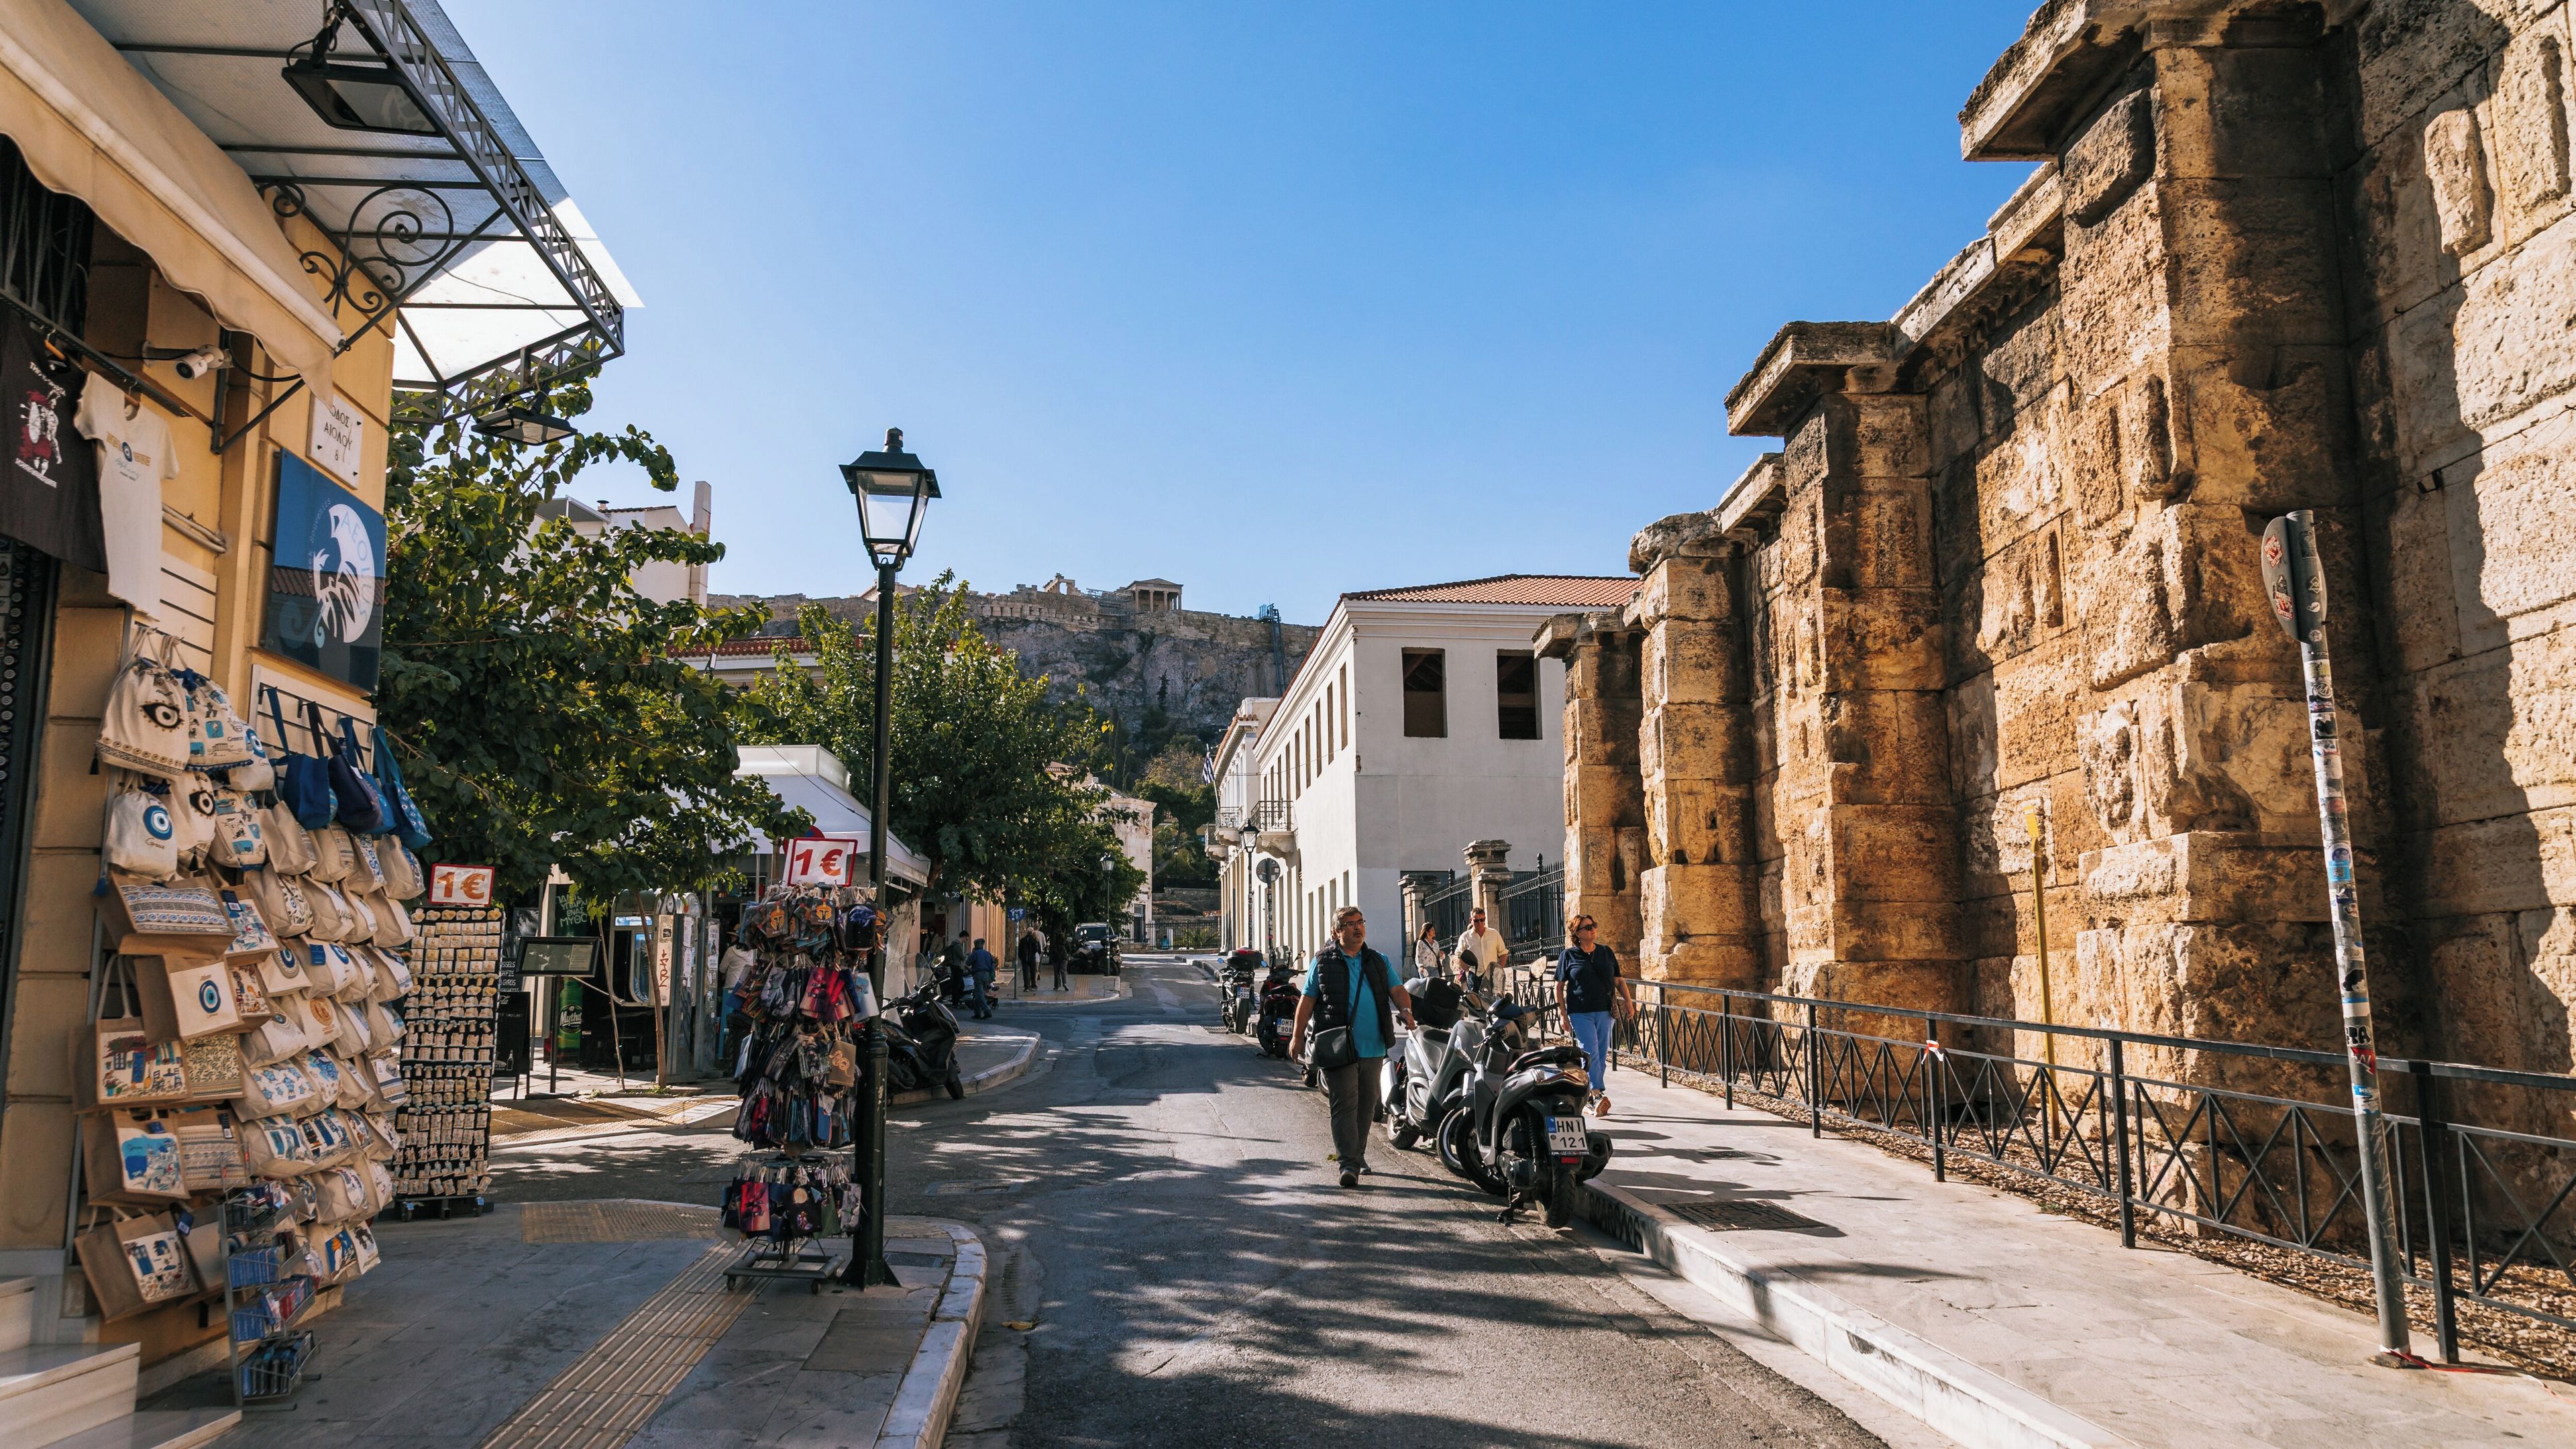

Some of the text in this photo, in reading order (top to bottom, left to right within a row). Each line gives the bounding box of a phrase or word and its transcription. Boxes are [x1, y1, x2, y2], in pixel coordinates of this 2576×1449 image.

[323, 421, 353, 451] ΑΙΟΛΟΥ
[340, 511, 372, 619] AEOLUS
[559, 913, 588, 927] ΜΥΘΟ
[1559, 1136, 1586, 1148] 121
